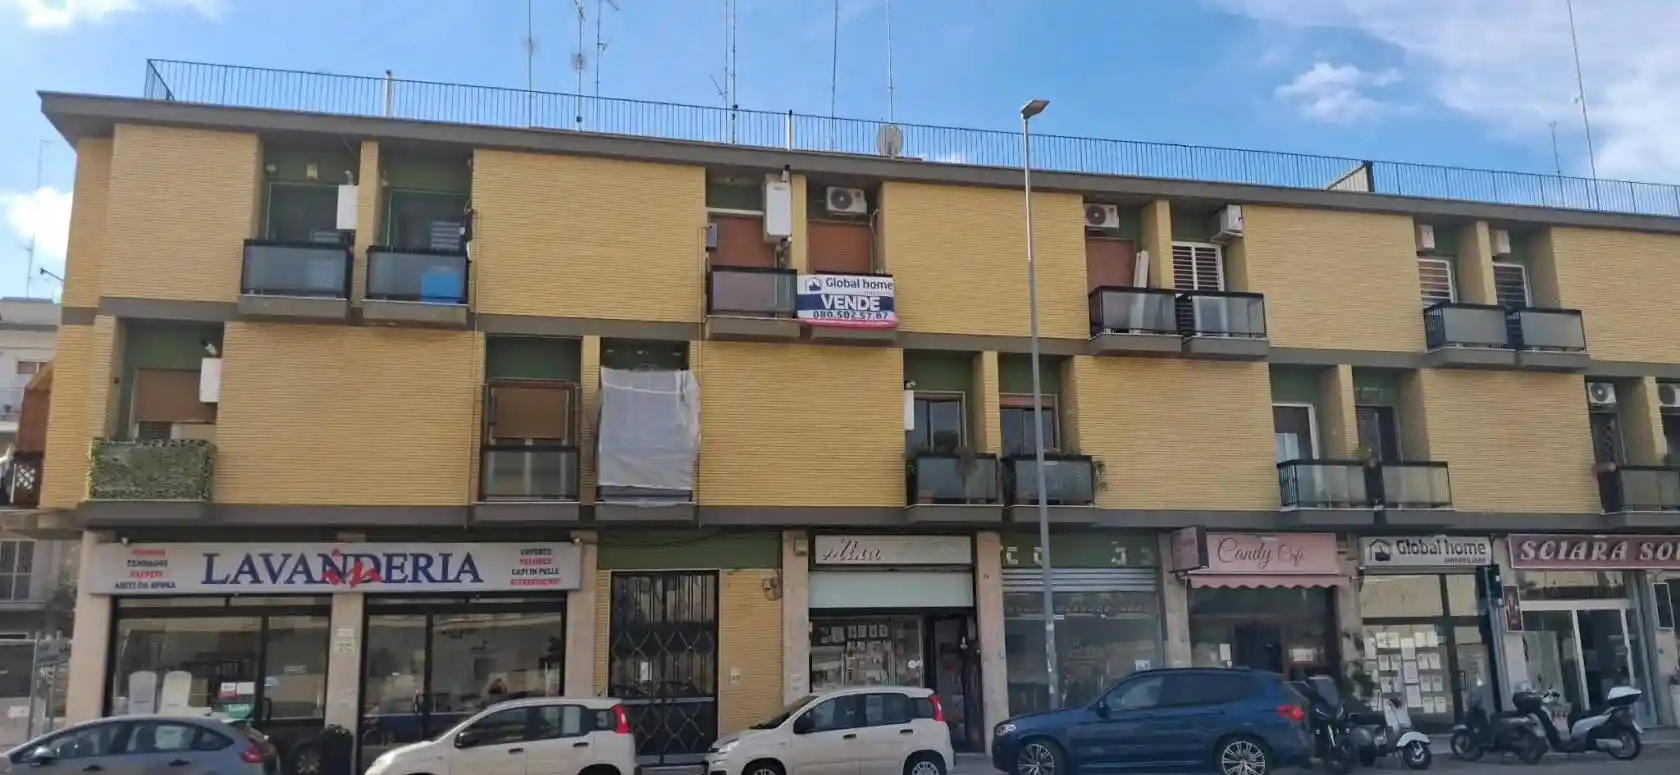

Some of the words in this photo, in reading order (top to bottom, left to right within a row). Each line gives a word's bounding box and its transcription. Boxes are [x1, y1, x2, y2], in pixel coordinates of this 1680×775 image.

[825, 277, 860, 288] Global
[862, 278, 893, 290] home
[820, 294, 881, 311] VENDE
[1217, 537, 1272, 568] Candy
[1396, 539, 1442, 555] Global
[1445, 539, 1487, 555] home
[1520, 540, 1628, 561] SCIARA
[201, 552, 484, 585] LAVANDERIA
